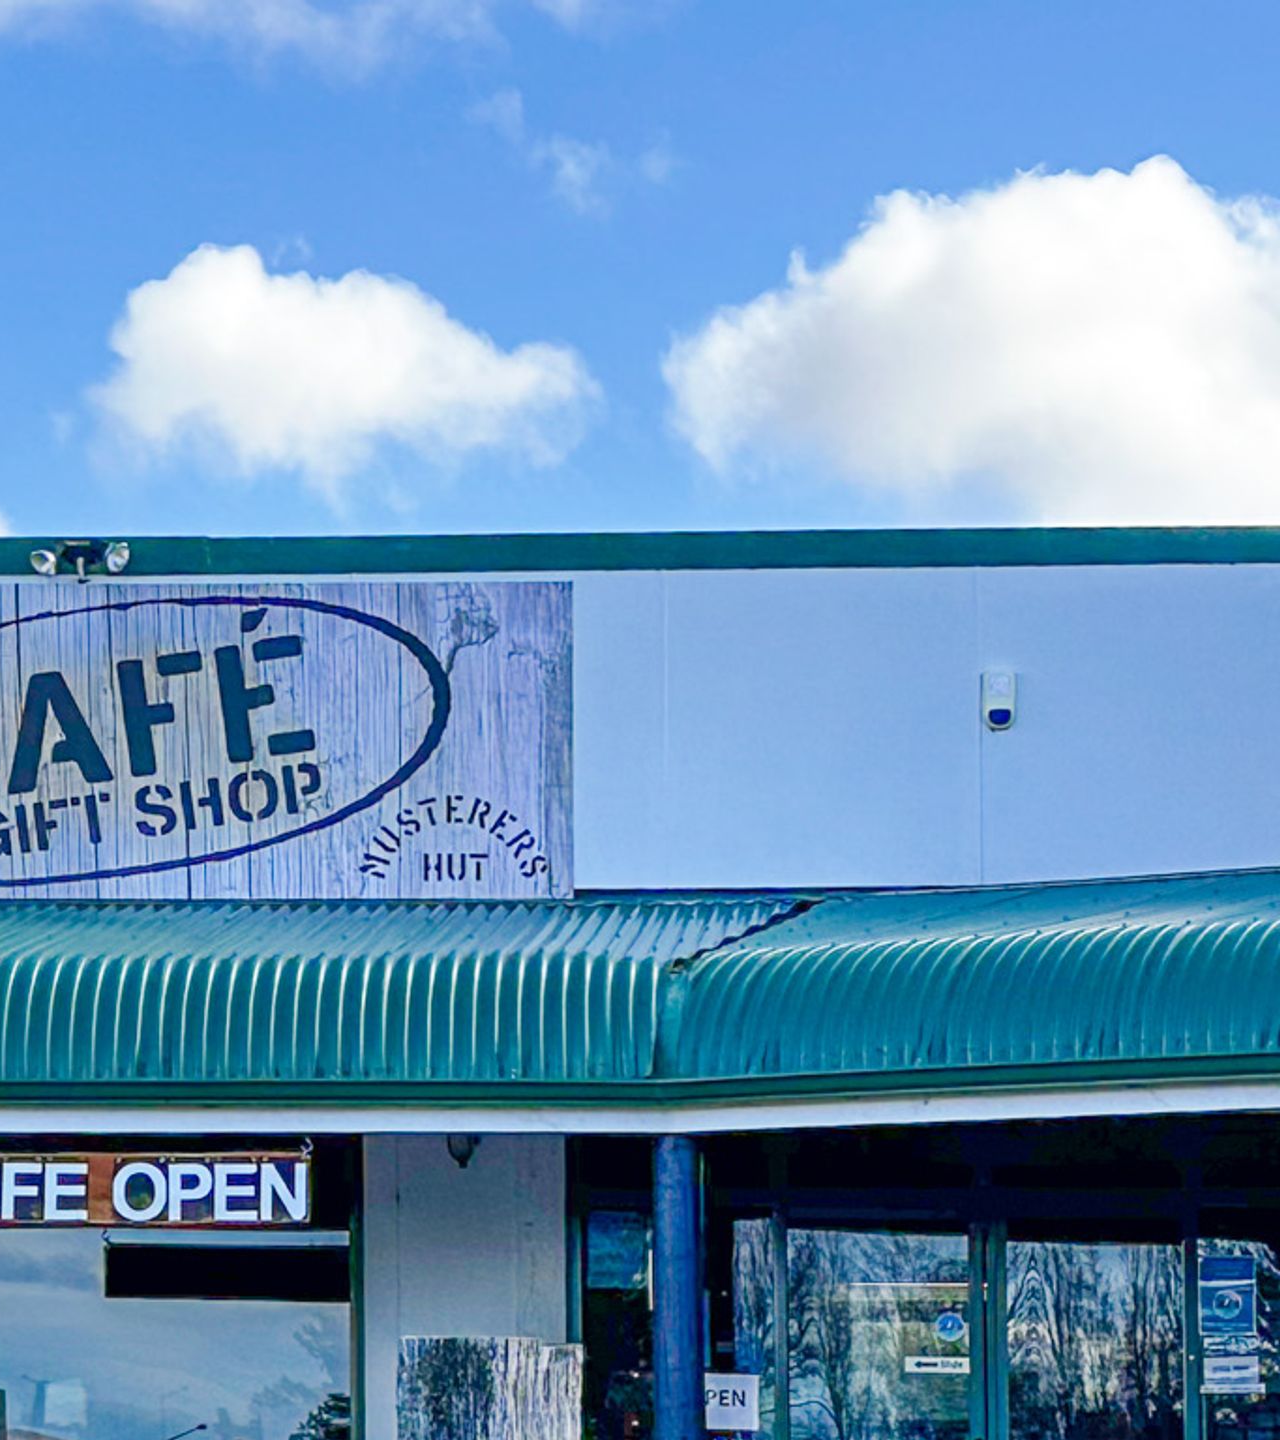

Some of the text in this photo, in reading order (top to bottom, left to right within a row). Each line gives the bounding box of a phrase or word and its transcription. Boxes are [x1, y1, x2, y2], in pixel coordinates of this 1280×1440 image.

[135, 763, 321, 836] SHOP
[360, 795, 547, 878] MUSTERERS
[423, 853, 489, 881] HUT
[112, 1161, 309, 1222] OPEN
[705, 1389, 746, 1407] PEN
